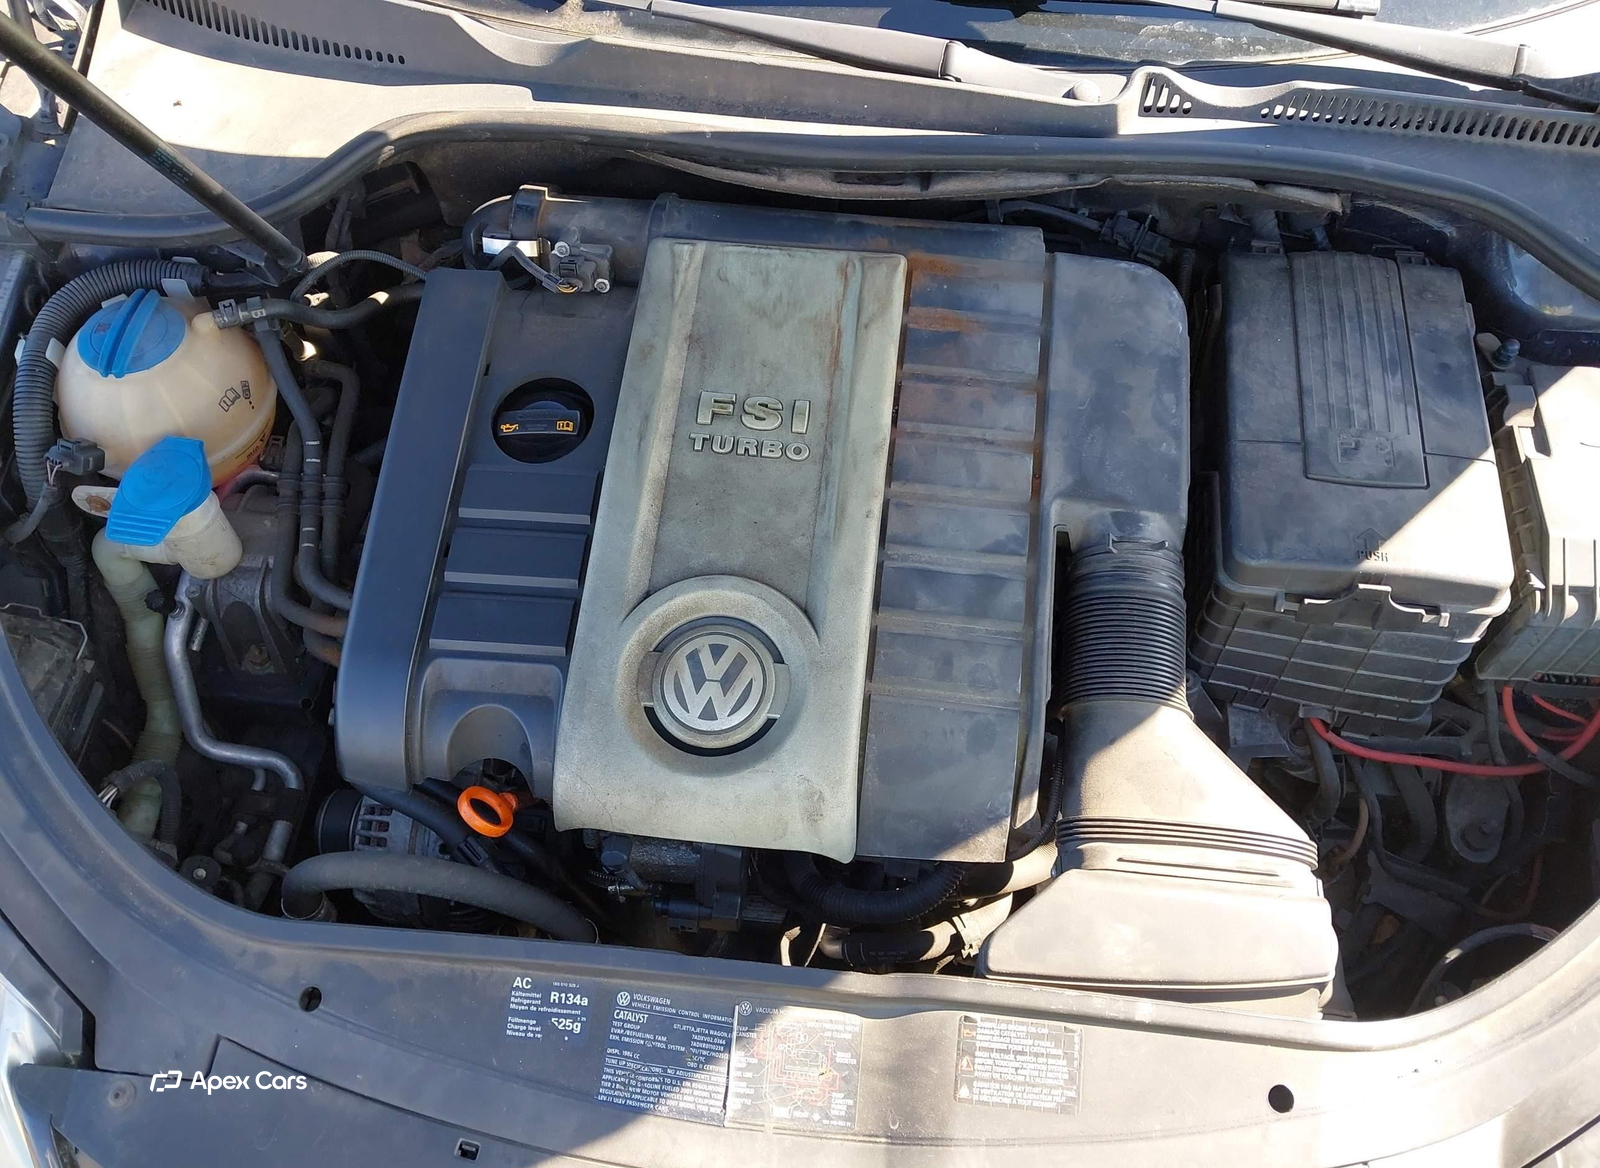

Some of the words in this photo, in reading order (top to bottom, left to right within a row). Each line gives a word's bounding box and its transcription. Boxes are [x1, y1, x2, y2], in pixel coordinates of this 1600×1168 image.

[696, 390, 811, 434] FSI
[689, 432, 810, 462] TURBO
[513, 977, 532, 989] AC
[511, 990, 541, 998] Kältemittel
[550, 991, 588, 1006] R134a
[511, 997, 541, 1005] Refrigerant
[633, 993, 671, 1005] VOLKSWAGEN
[538, 1006, 581, 1015] refroidissement
[632, 1001, 651, 1009] VEHICLE
[653, 1005, 676, 1014] EMISSION
[678, 1009, 700, 1018] CONTROL
[702, 1013, 733, 1023] INFORMATIO
[755, 1006, 779, 1015] VACUUM
[508, 1016, 536, 1025] Füllmenge
[614, 1009, 648, 1023] CATALYST
[507, 1023, 526, 1031] Charge
[710, 1029, 731, 1039] WAGON,E
[621, 1036, 644, 1045] EMISSION
[667, 1044, 686, 1052] SYSTEM
[704, 1065, 726, 1073] CERTIFIE
[637, 1081, 661, 1090] GSOLINE
[631, 1094, 657, 1103] APPLICABLE
[661, 1092, 682, 1100] VEHICLES
[626, 1100, 654, 1109] PASSENGER
